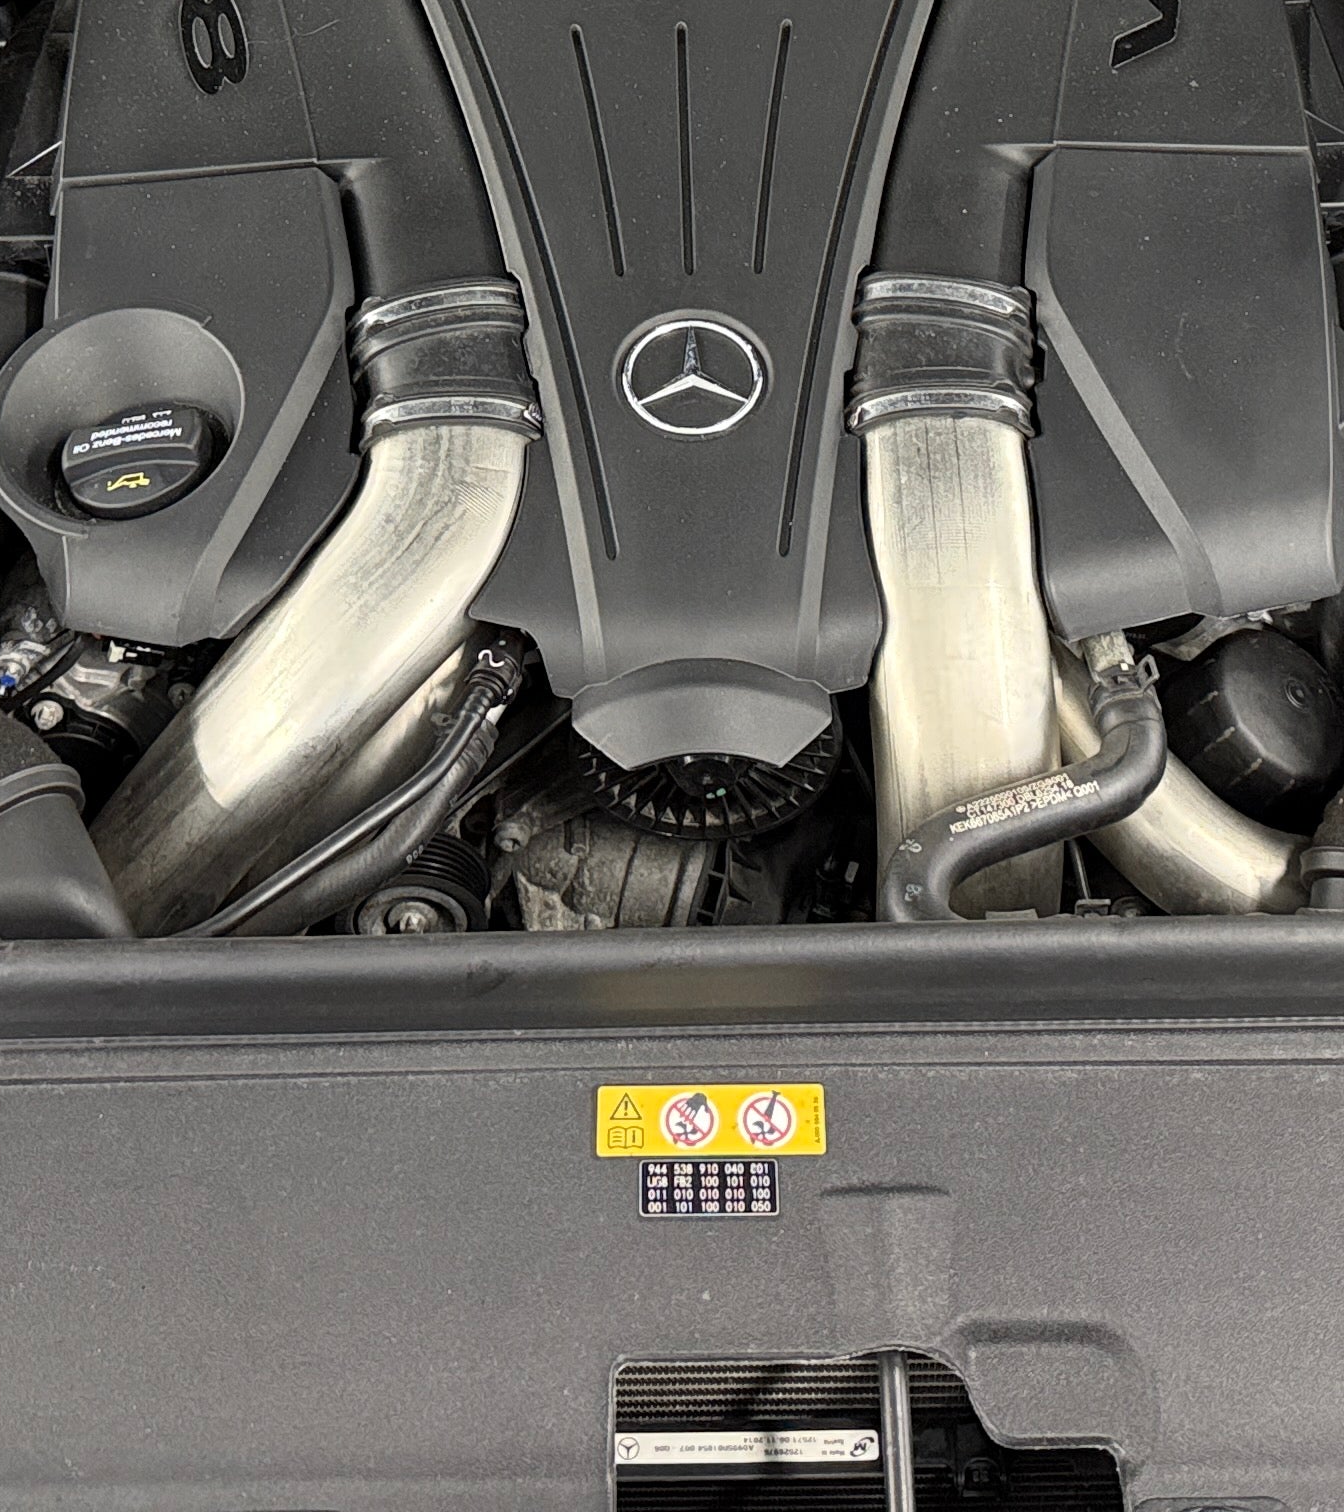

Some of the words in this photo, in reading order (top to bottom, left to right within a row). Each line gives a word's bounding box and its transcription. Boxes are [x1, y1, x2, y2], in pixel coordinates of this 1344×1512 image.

[90, 419, 173, 441] recommended
[92, 428, 182, 448] Mercedes-Benz
[73, 443, 90, 454] Oil
[699, 1163, 718, 1175] 910
[724, 1163, 744, 1175] 040
[701, 1176, 719, 1188] 100
[726, 1176, 744, 1188] 101
[750, 1176, 770, 1188] 010
[648, 1188, 667, 1200] 011
[673, 1188, 693, 1200] 010
[699, 1188, 719, 1200] 010
[725, 1188, 745, 1200] 010
[752, 1188, 771, 1200] 100
[648, 1201, 667, 1213] 001
[676, 1201, 693, 1213] 101
[701, 1201, 720, 1213] 100
[725, 1201, 745, 1213] 010
[751, 1201, 771, 1213] 050
